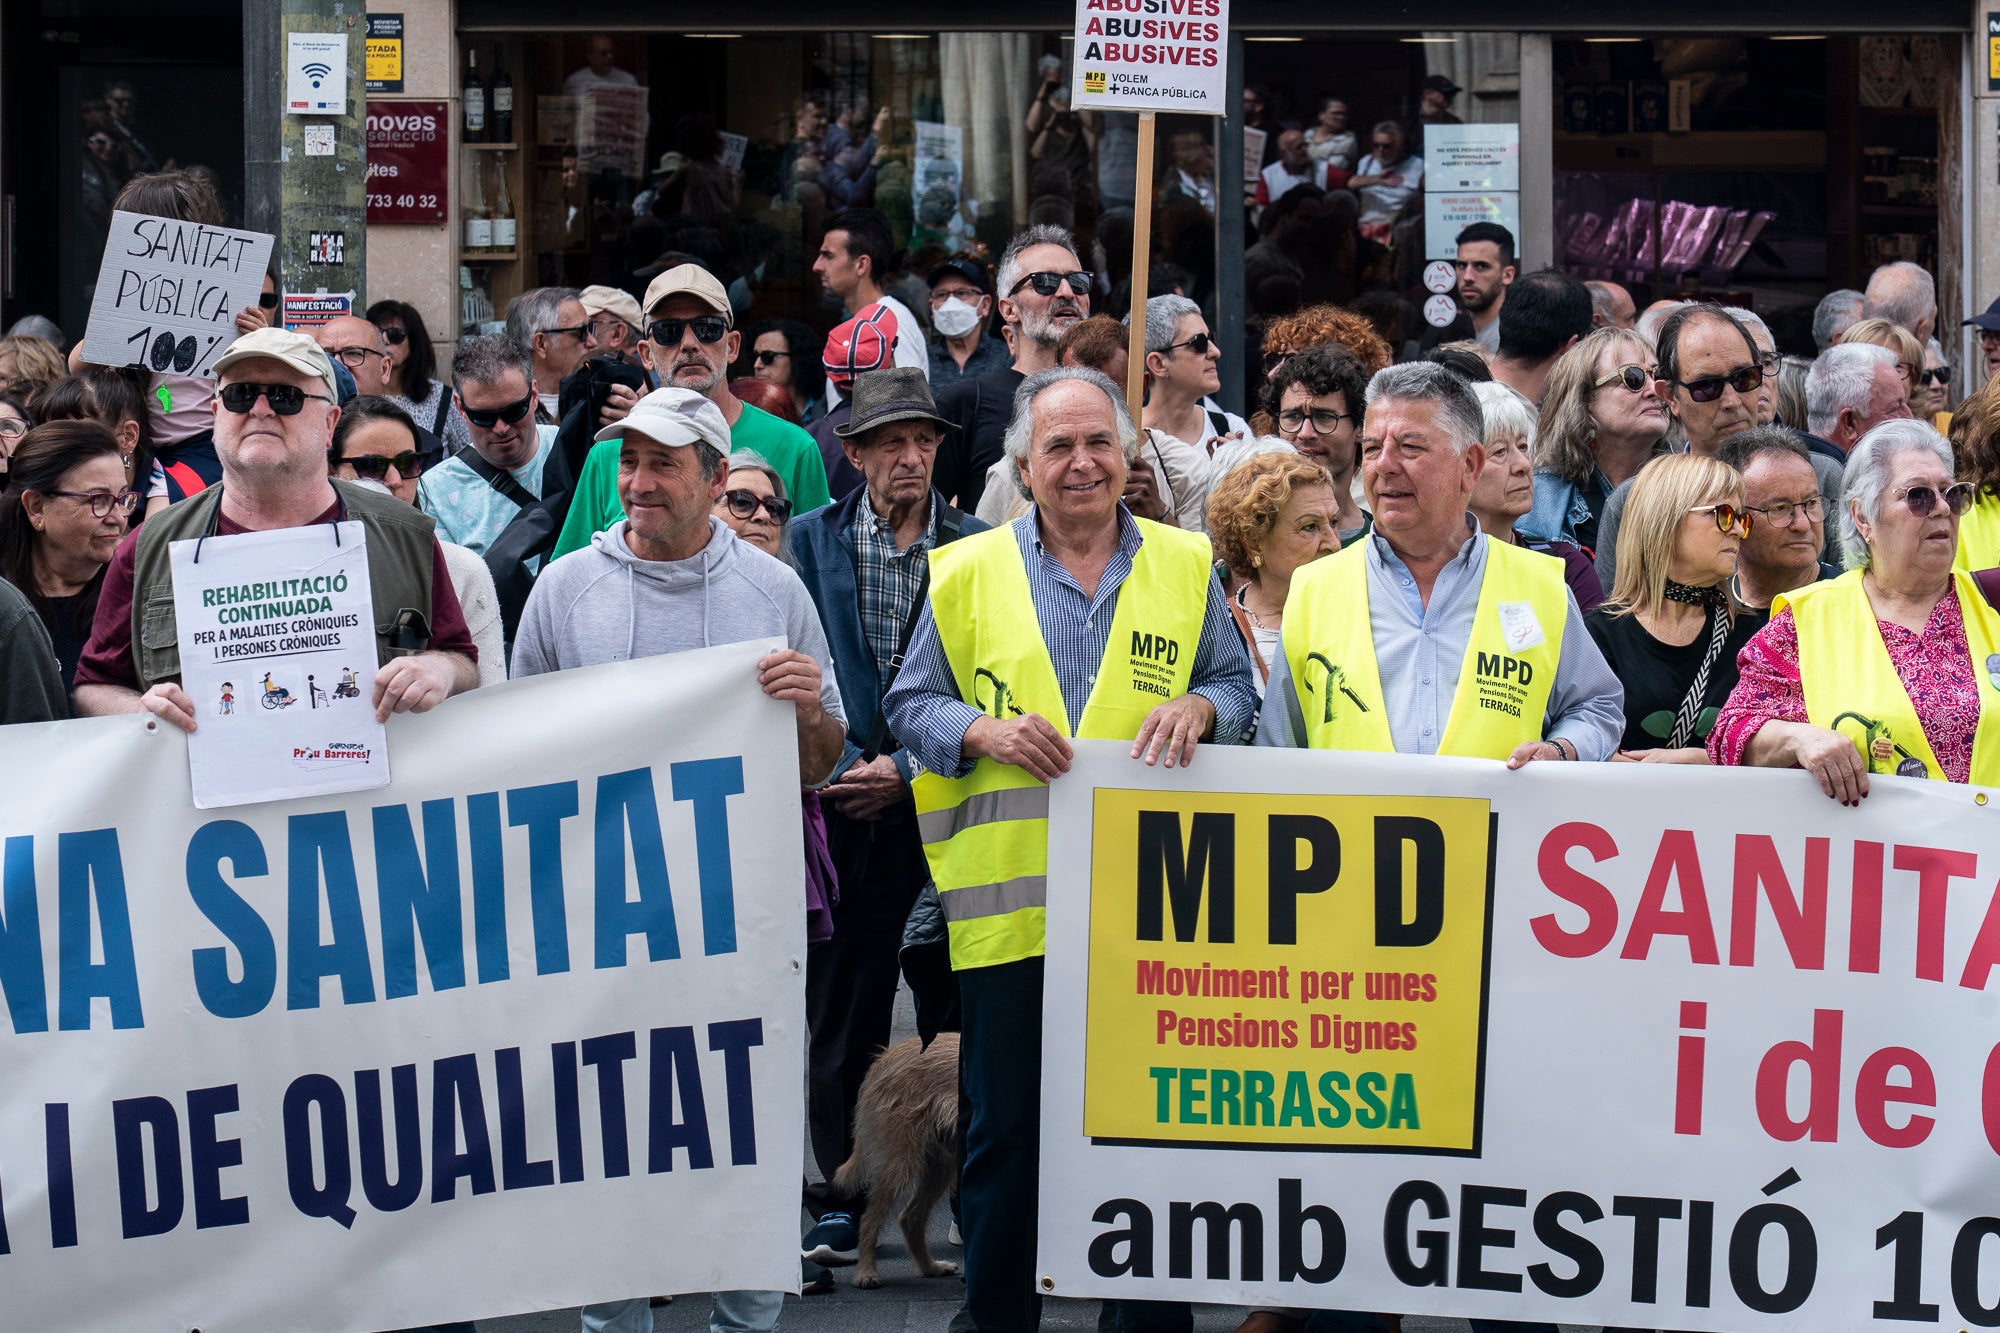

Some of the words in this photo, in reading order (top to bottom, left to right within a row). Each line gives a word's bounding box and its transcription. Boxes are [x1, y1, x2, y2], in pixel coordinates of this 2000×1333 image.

[1085, 72, 1106, 81] MPD
[1112, 73, 1148, 83] VOLEM
[1122, 86, 1159, 97] BANCA
[366, 115, 436, 131] novas
[368, 131, 436, 141] selecció
[366, 194, 392, 207] 733
[396, 194, 414, 207] 40
[419, 194, 437, 207] 32
[286, 299, 343, 310] MANIFESTACIÓ
[126, 327, 224, 376] 100%
[203, 569, 348, 608] REHABILITACIÓ
[217, 596, 333, 624] CONTINUADA
[194, 630, 215, 645] PER
[219, 629, 227, 642] A
[229, 621, 288, 640] MALALTIES
[214, 647, 219, 658] I
[222, 639, 276, 658] PERSONES
[279, 632, 341, 650] CRÒNIQUES
[1131, 630, 1178, 666] MPD
[1130, 659, 1158, 670] Moviment
[1133, 669, 1158, 680] Pensions
[1476, 651, 1533, 686] MPD
[1132, 680, 1171, 698] TERRASSA
[1476, 678, 1508, 689] Moviment
[1508, 684, 1517, 692] per
[1480, 687, 1507, 698] Pensions
[1479, 697, 1521, 718] TERRASSA
[185, 756, 744, 1019] SANITAT
[1136, 960, 1290, 1000] Moviment
[1300, 969, 1355, 1004] per
[1365, 971, 1437, 1002] unes
[1156, 1010, 1299, 1050] Pensions
[1310, 1014, 1418, 1055] Dignes
[1674, 1000, 1708, 1135] i
[1755, 1009, 1937, 1149] de
[1149, 1066, 1421, 1131] TERRASSA
[45, 1102, 78, 1249] I
[112, 1083, 250, 1240] DE
[282, 1017, 764, 1230] QUALITAT
[1087, 1177, 1347, 1284] amb
[1383, 1166, 1818, 1314] GESTIÓ
